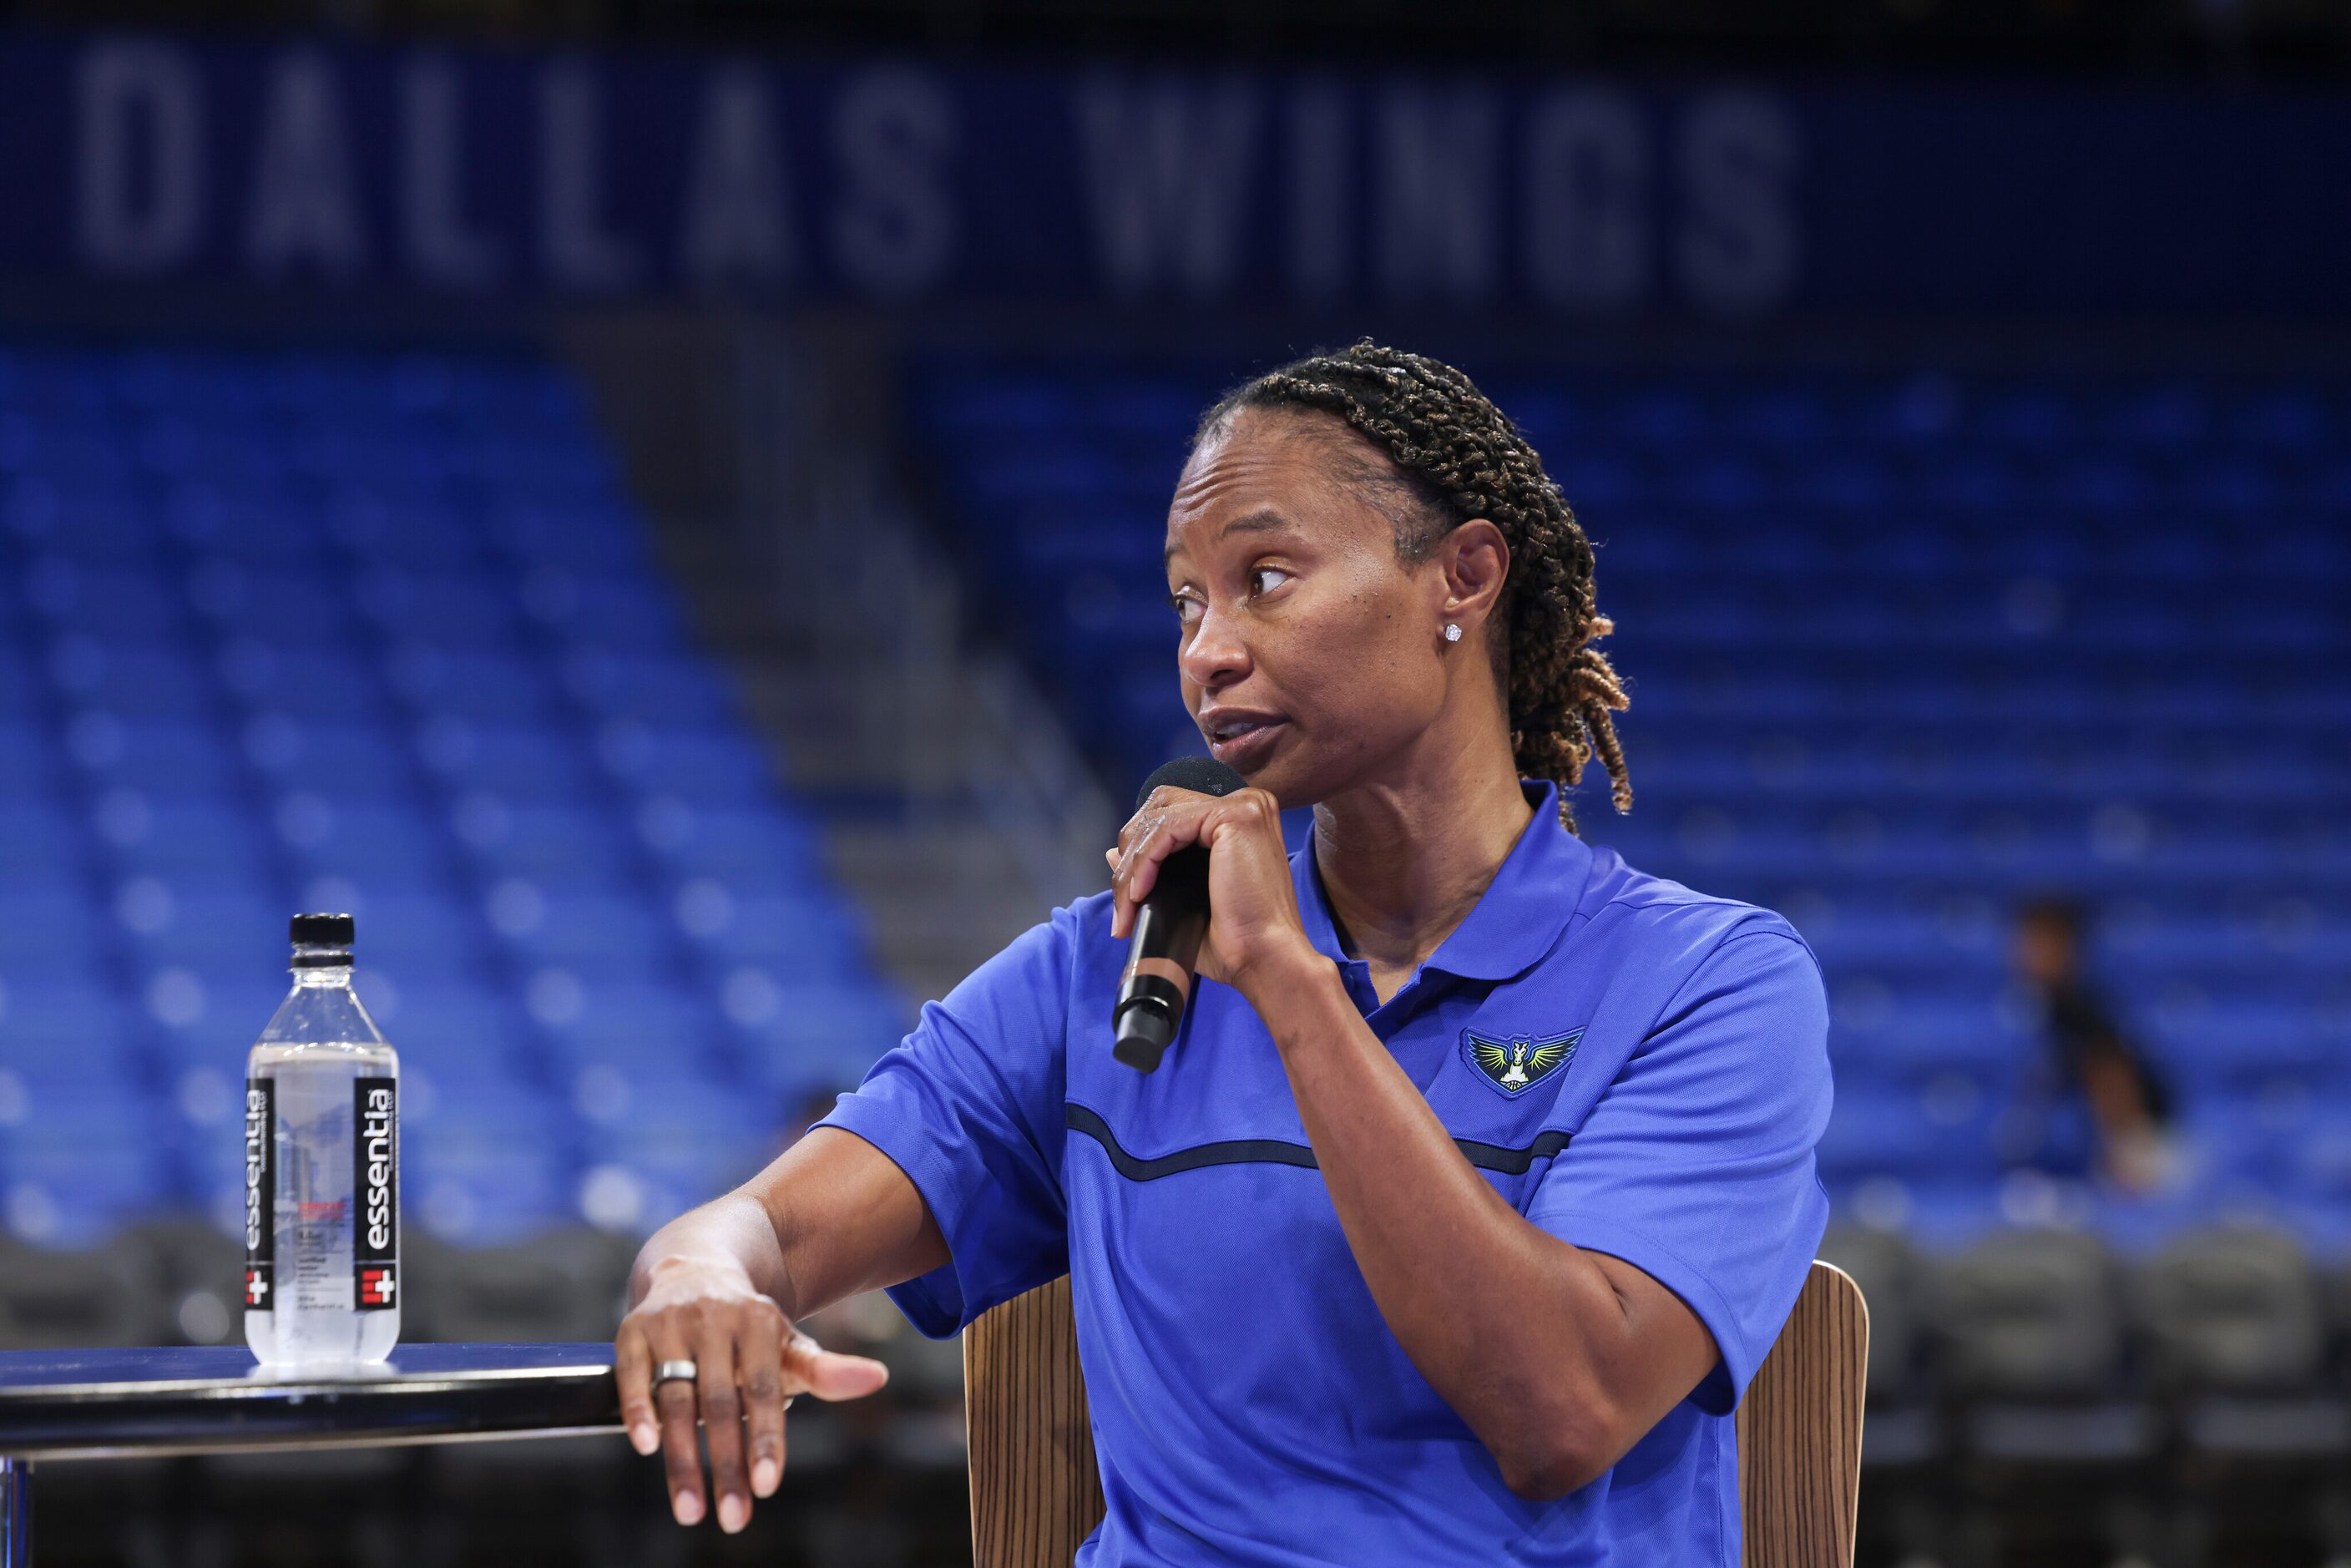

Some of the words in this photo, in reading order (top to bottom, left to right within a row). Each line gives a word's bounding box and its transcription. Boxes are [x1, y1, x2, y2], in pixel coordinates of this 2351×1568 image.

[75, 40, 958, 294] DALLAS
[1070, 73, 1805, 316] WINGS
[245, 1089, 261, 1251] essentia
[362, 1088, 390, 1250] essentia
